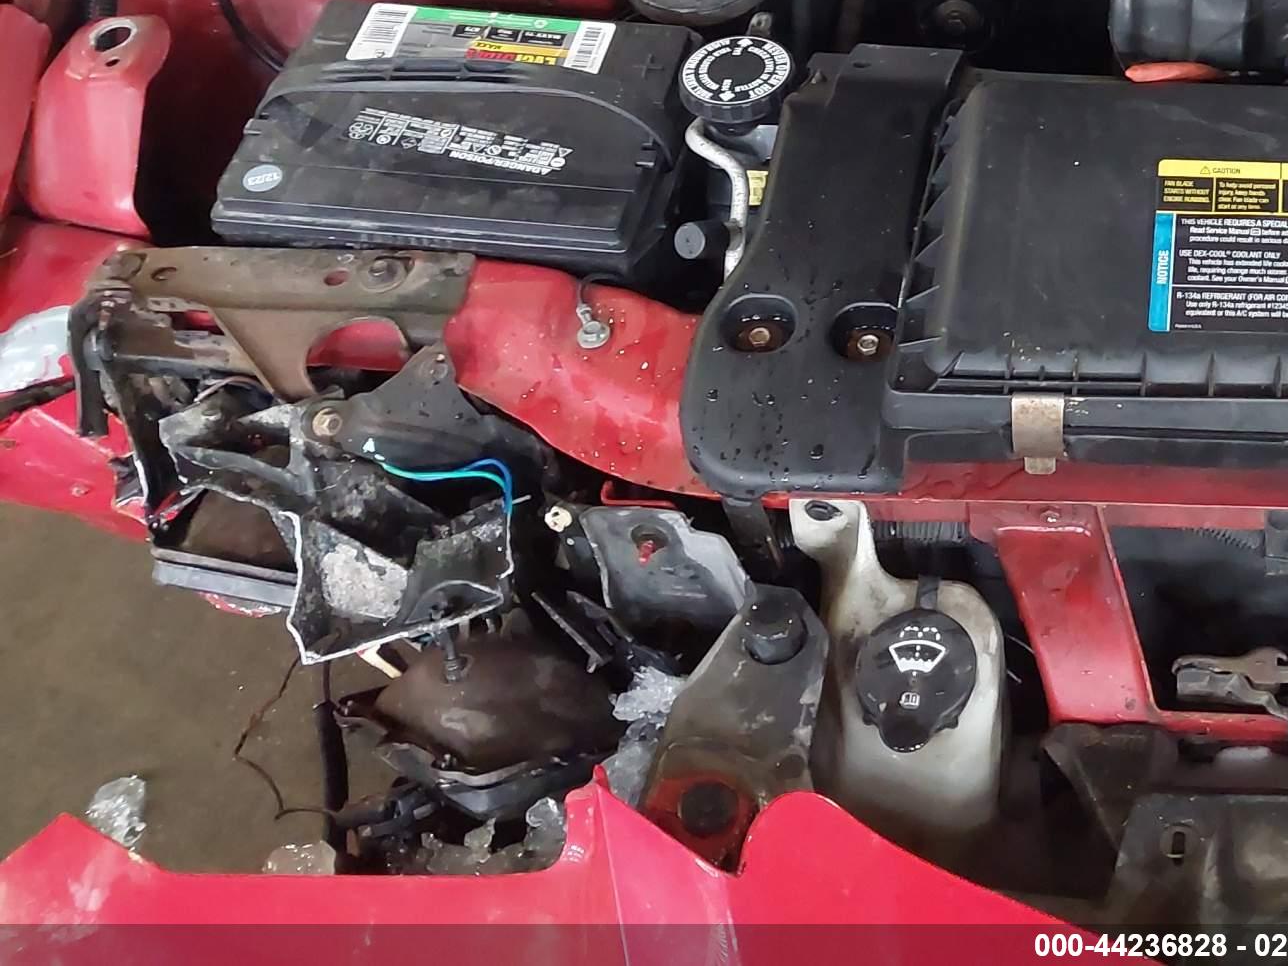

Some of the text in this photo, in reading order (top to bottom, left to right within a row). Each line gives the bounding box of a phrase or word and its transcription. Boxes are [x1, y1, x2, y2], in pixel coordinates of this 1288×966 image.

[748, 42, 787, 99] NEVER OPEN HOT
[1157, 249, 1170, 285] NOTICE
